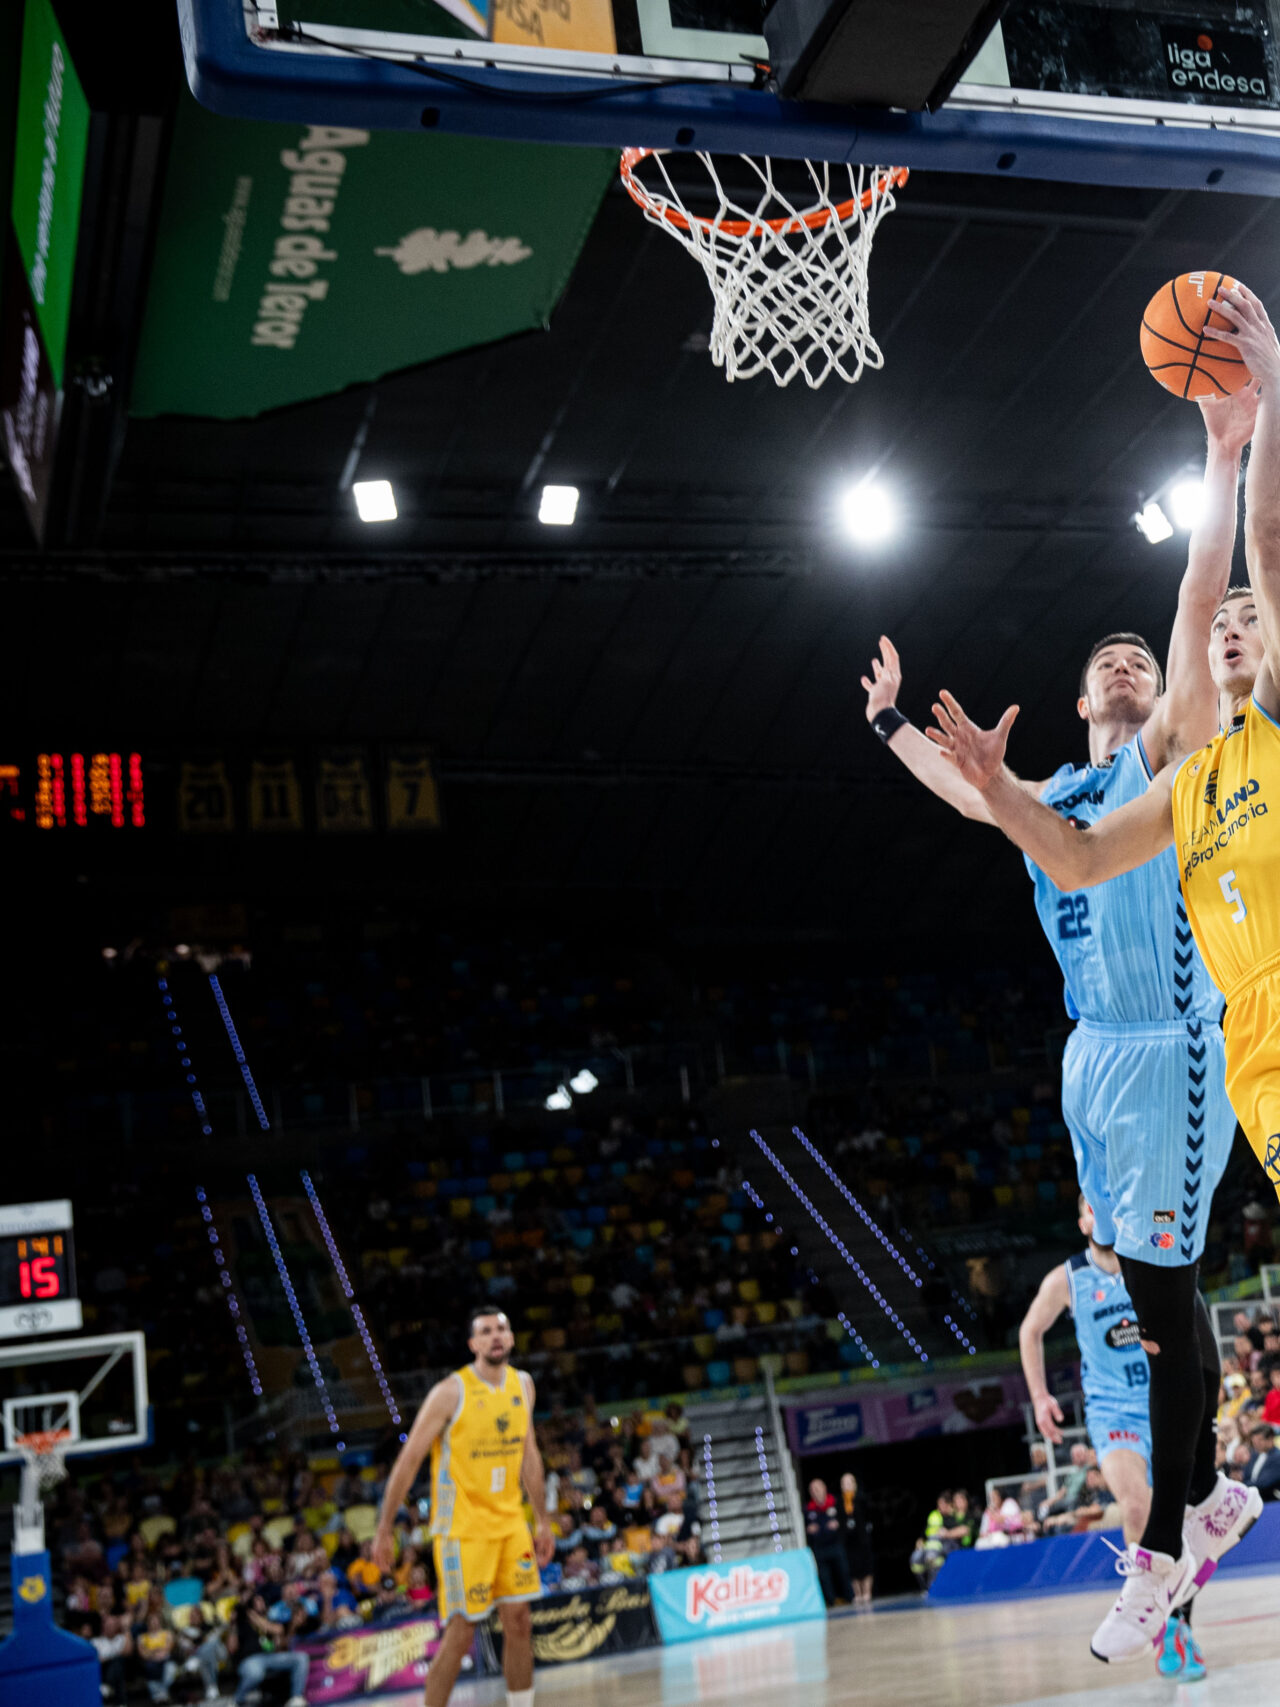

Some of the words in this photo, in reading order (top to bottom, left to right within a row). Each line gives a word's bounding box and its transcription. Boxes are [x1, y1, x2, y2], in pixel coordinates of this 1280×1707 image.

[1168, 44, 1211, 69] liga
[1172, 69, 1266, 96] endesa
[280, 125, 370, 233] Aguas
[269, 233, 338, 279] de
[251, 279, 329, 348] Teror
[1183, 779, 1260, 861] DEAMLAND
[1057, 894, 1091, 940] 22
[1218, 869, 1248, 924] 5
[19, 1257, 60, 1298] 15
[1123, 1361, 1149, 1388] 19
